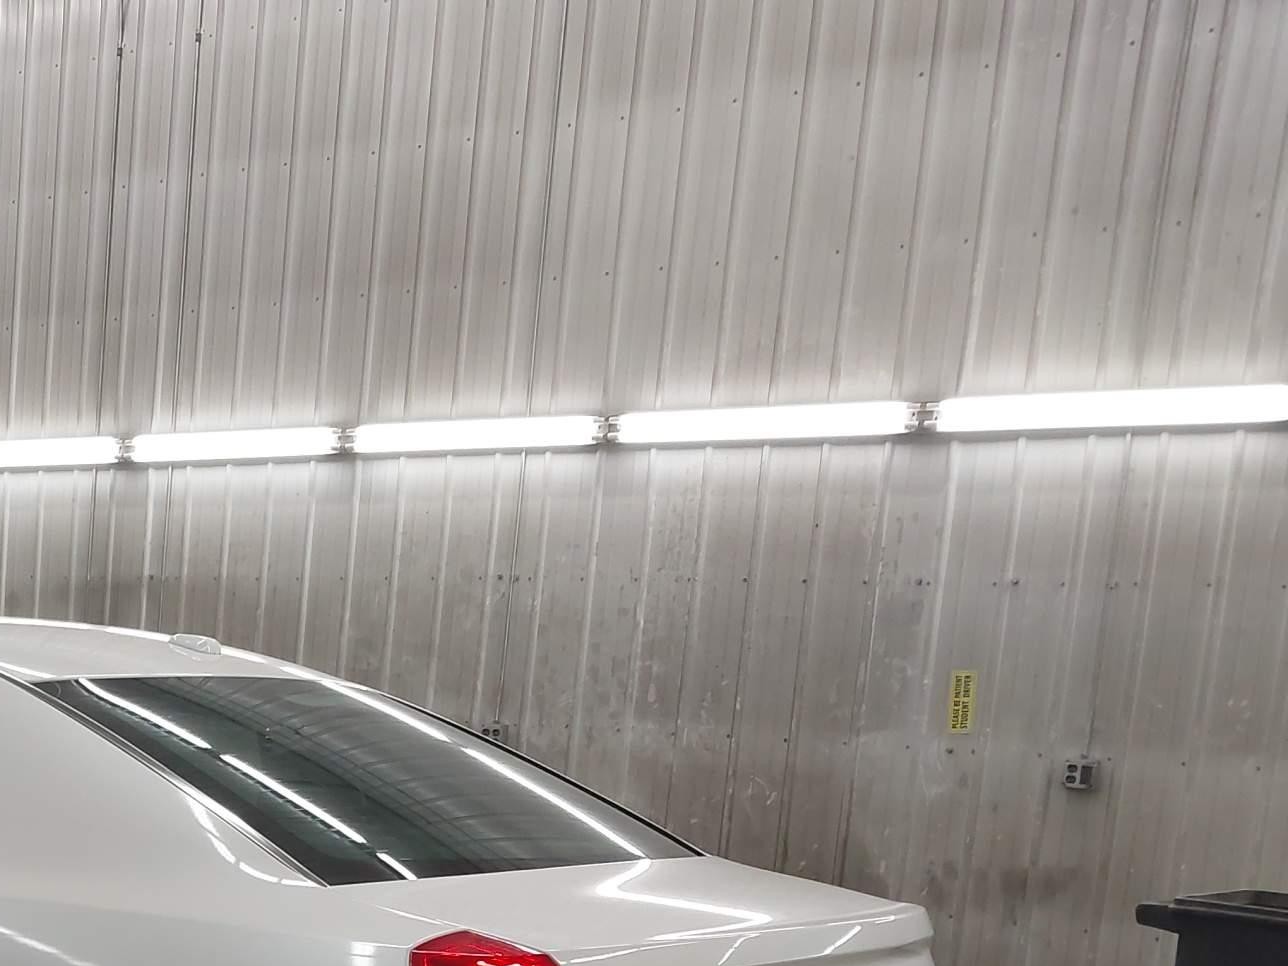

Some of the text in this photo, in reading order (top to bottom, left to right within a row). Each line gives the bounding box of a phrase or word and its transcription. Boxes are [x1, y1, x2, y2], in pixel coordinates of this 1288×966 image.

[954, 675, 963, 698] PATIENT
[960, 675, 972, 729] STUDENT DRIVER
[952, 709, 960, 729] PLEASE
